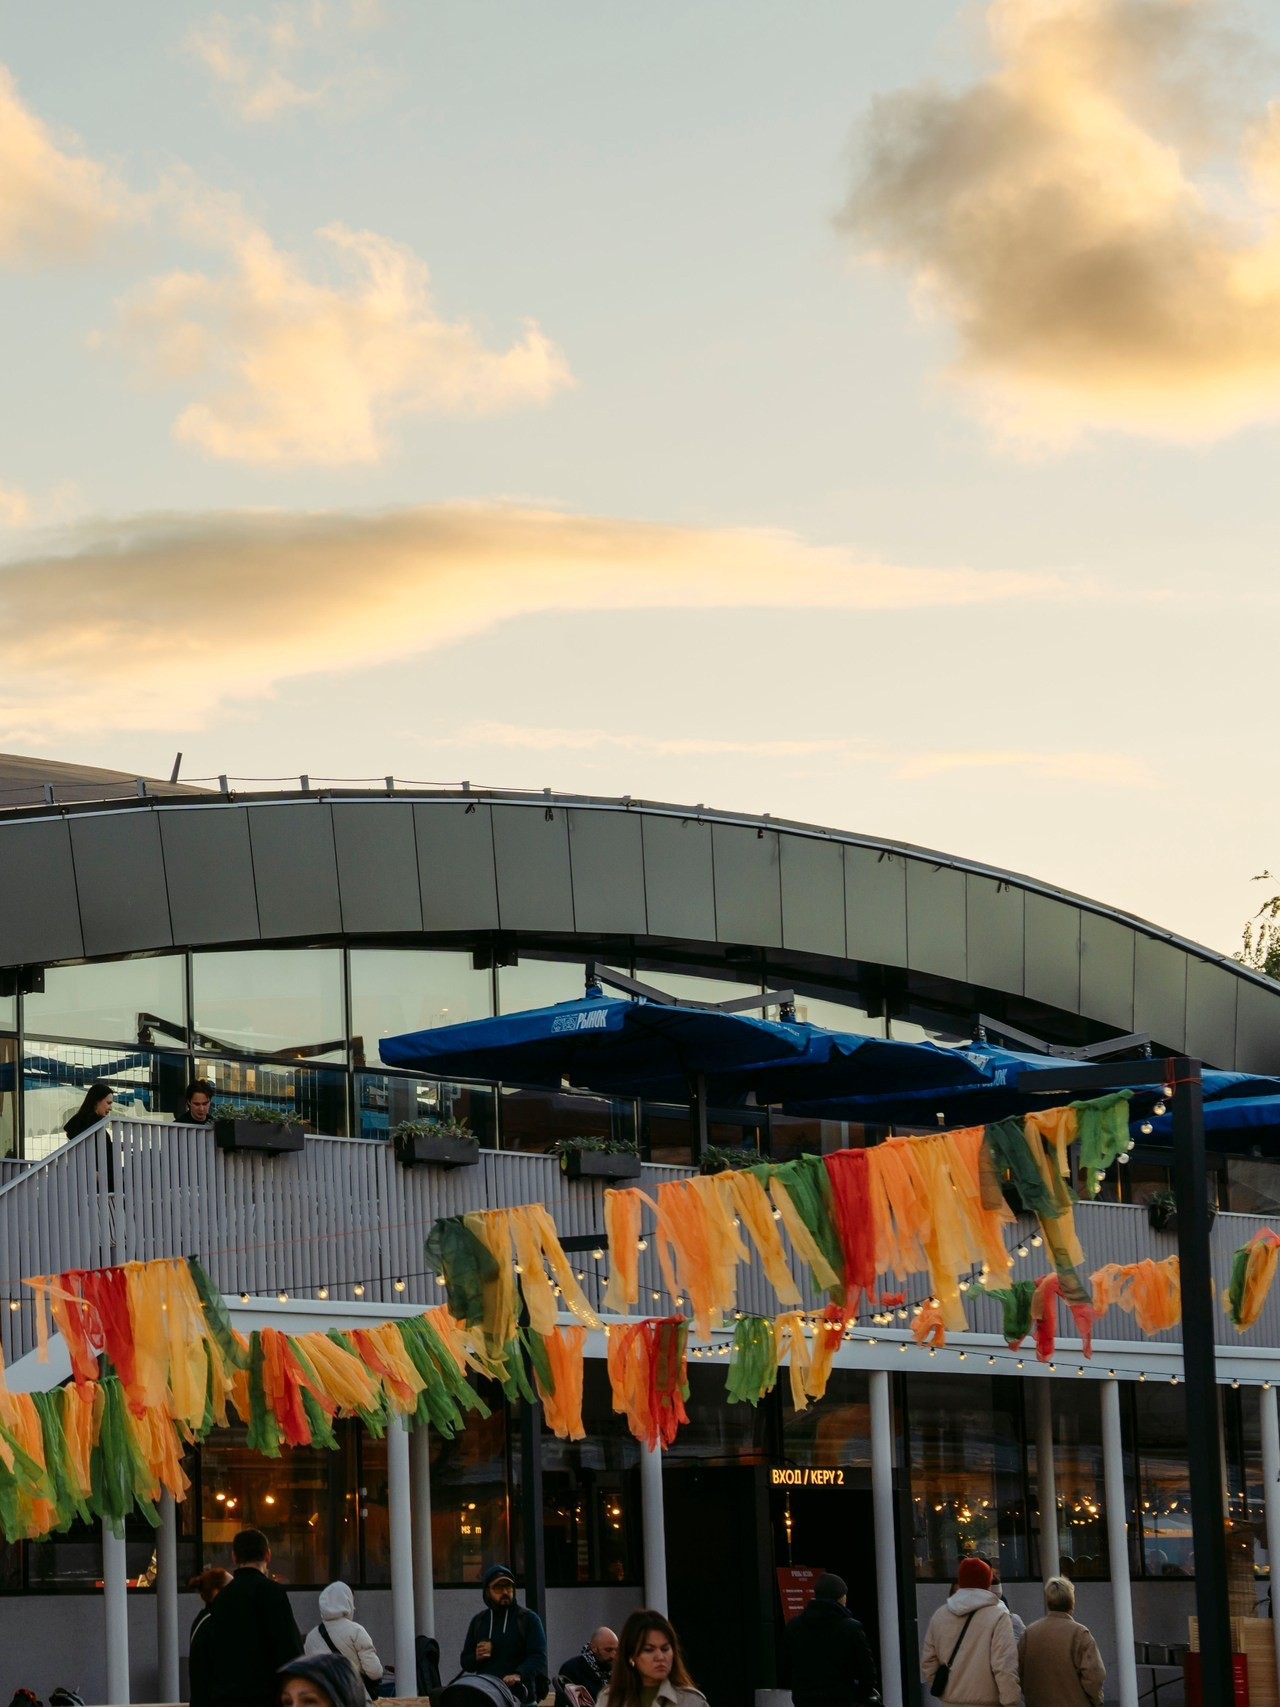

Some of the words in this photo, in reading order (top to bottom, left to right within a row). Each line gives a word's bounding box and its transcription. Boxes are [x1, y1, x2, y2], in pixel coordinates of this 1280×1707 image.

[575, 1009, 608, 1030] РЫНОК
[772, 1469, 802, 1484] ВХОД
[837, 1470, 844, 1484] 2
